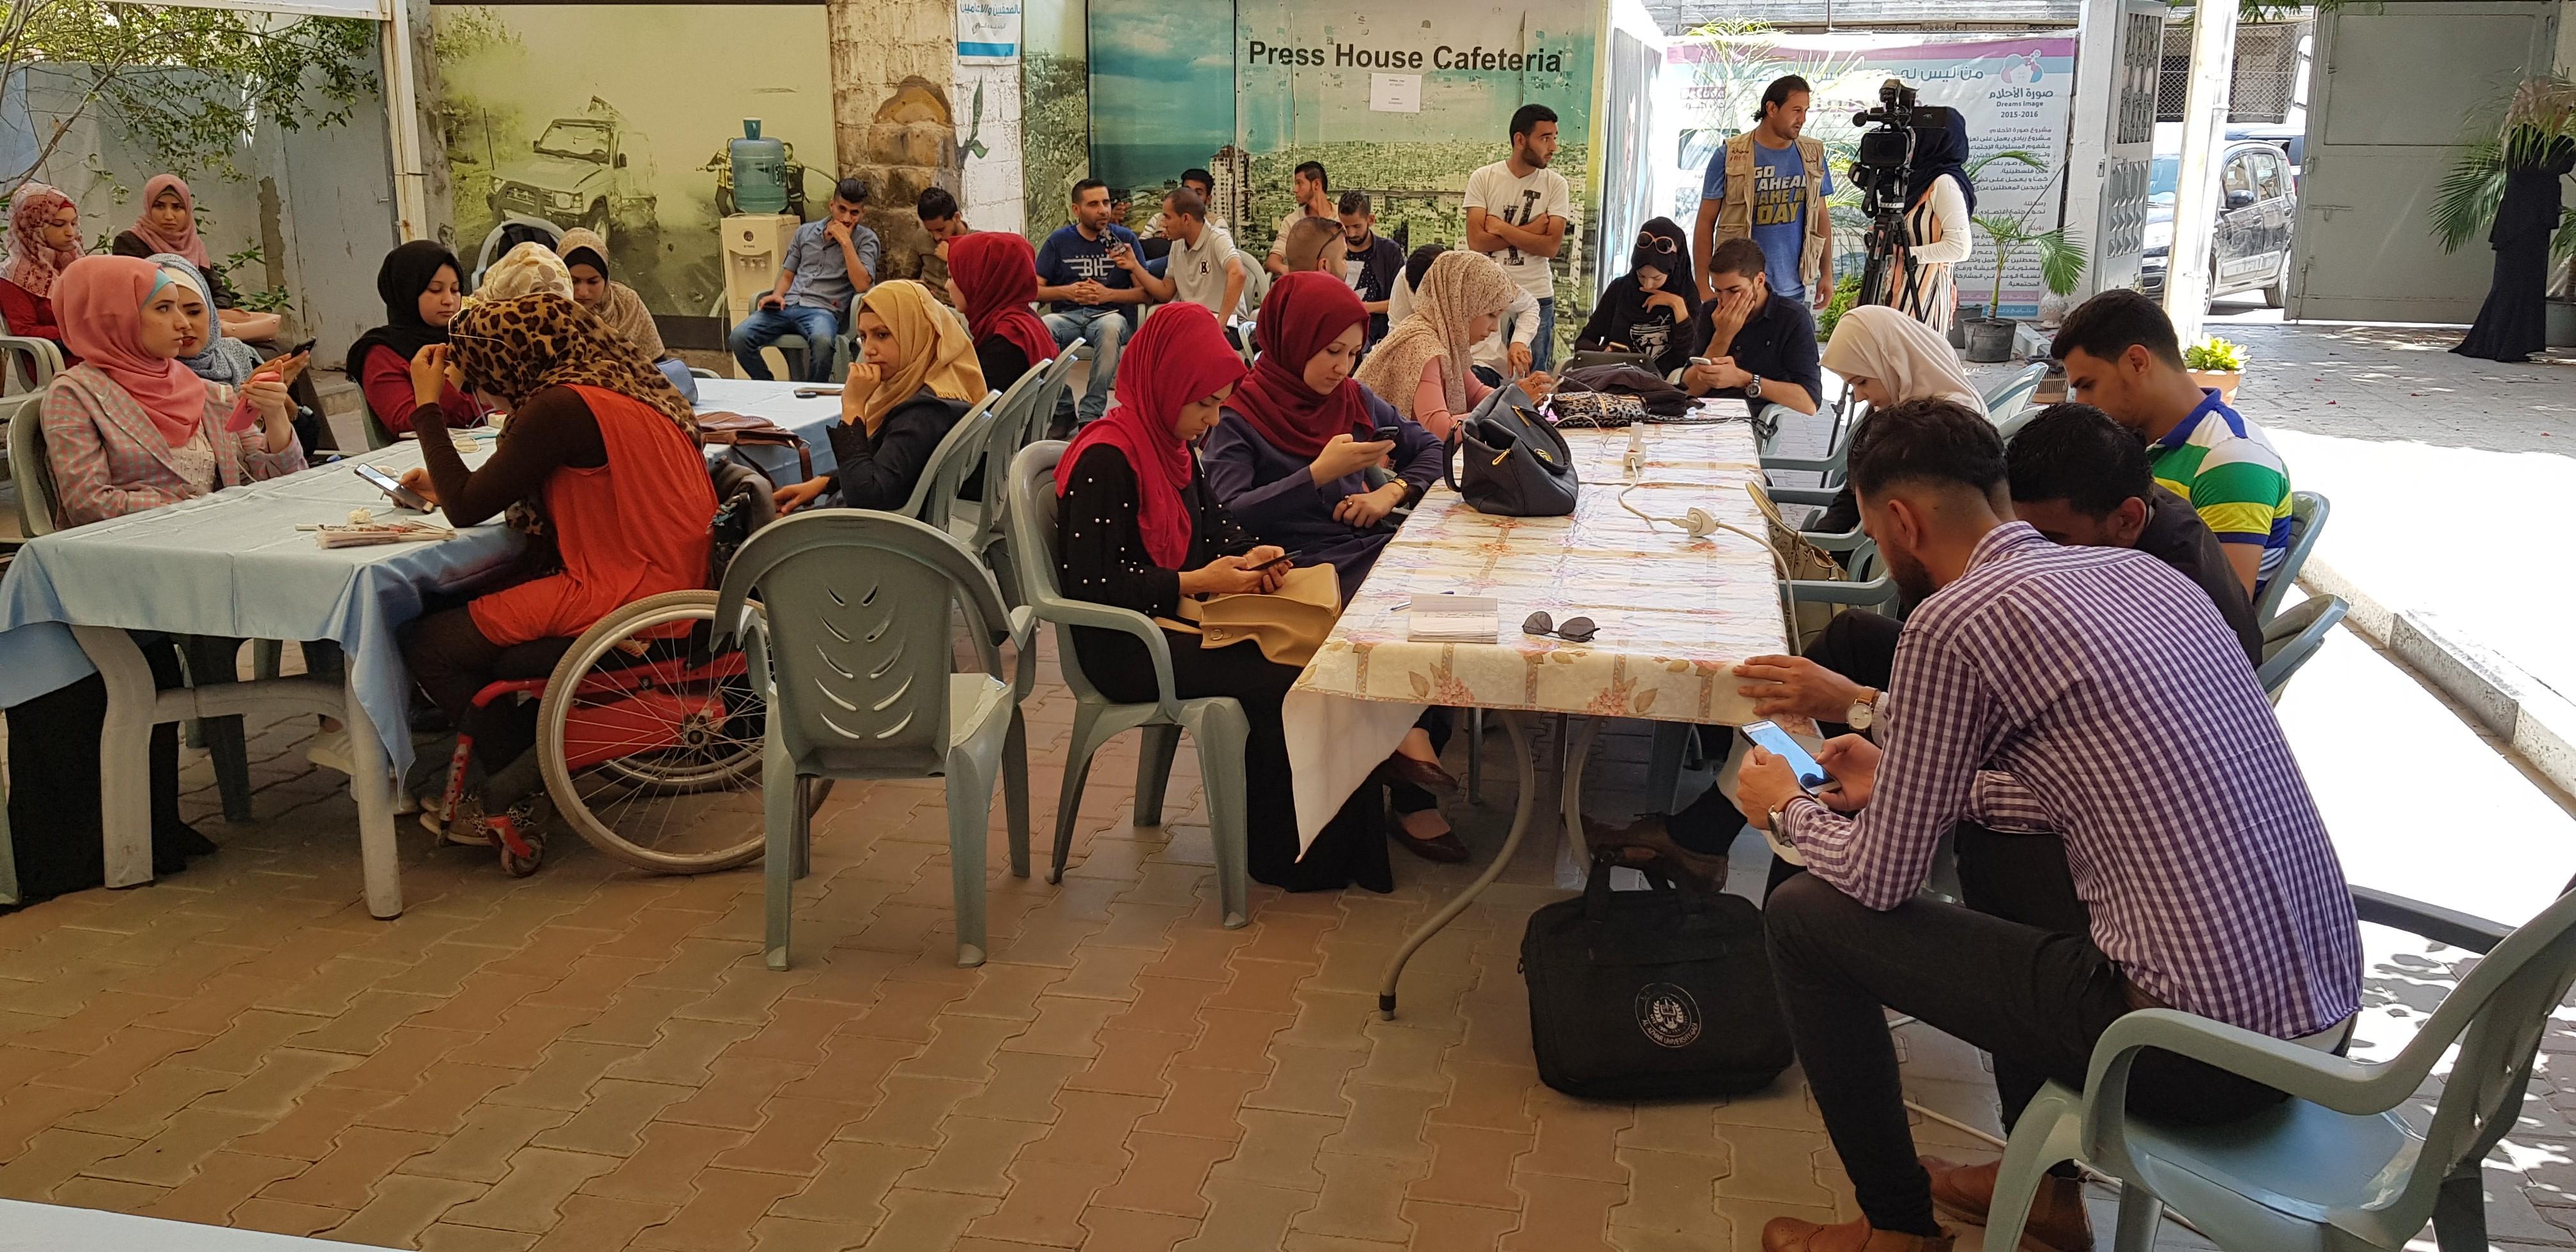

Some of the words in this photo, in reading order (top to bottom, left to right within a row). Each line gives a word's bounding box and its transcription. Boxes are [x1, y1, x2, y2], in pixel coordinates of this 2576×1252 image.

[1249, 41, 1325, 66] Press
[1335, 43, 1423, 68] House
[1432, 46, 1561, 73] Cafeteria
[1920, 67, 1956, 82] ليس
[1960, 66, 1983, 80] من
[1988, 87, 2023, 99] الأحلام
[2026, 88, 2053, 99] صورة
[1754, 165, 1775, 179] GO
[1757, 202, 1800, 225] DAY
